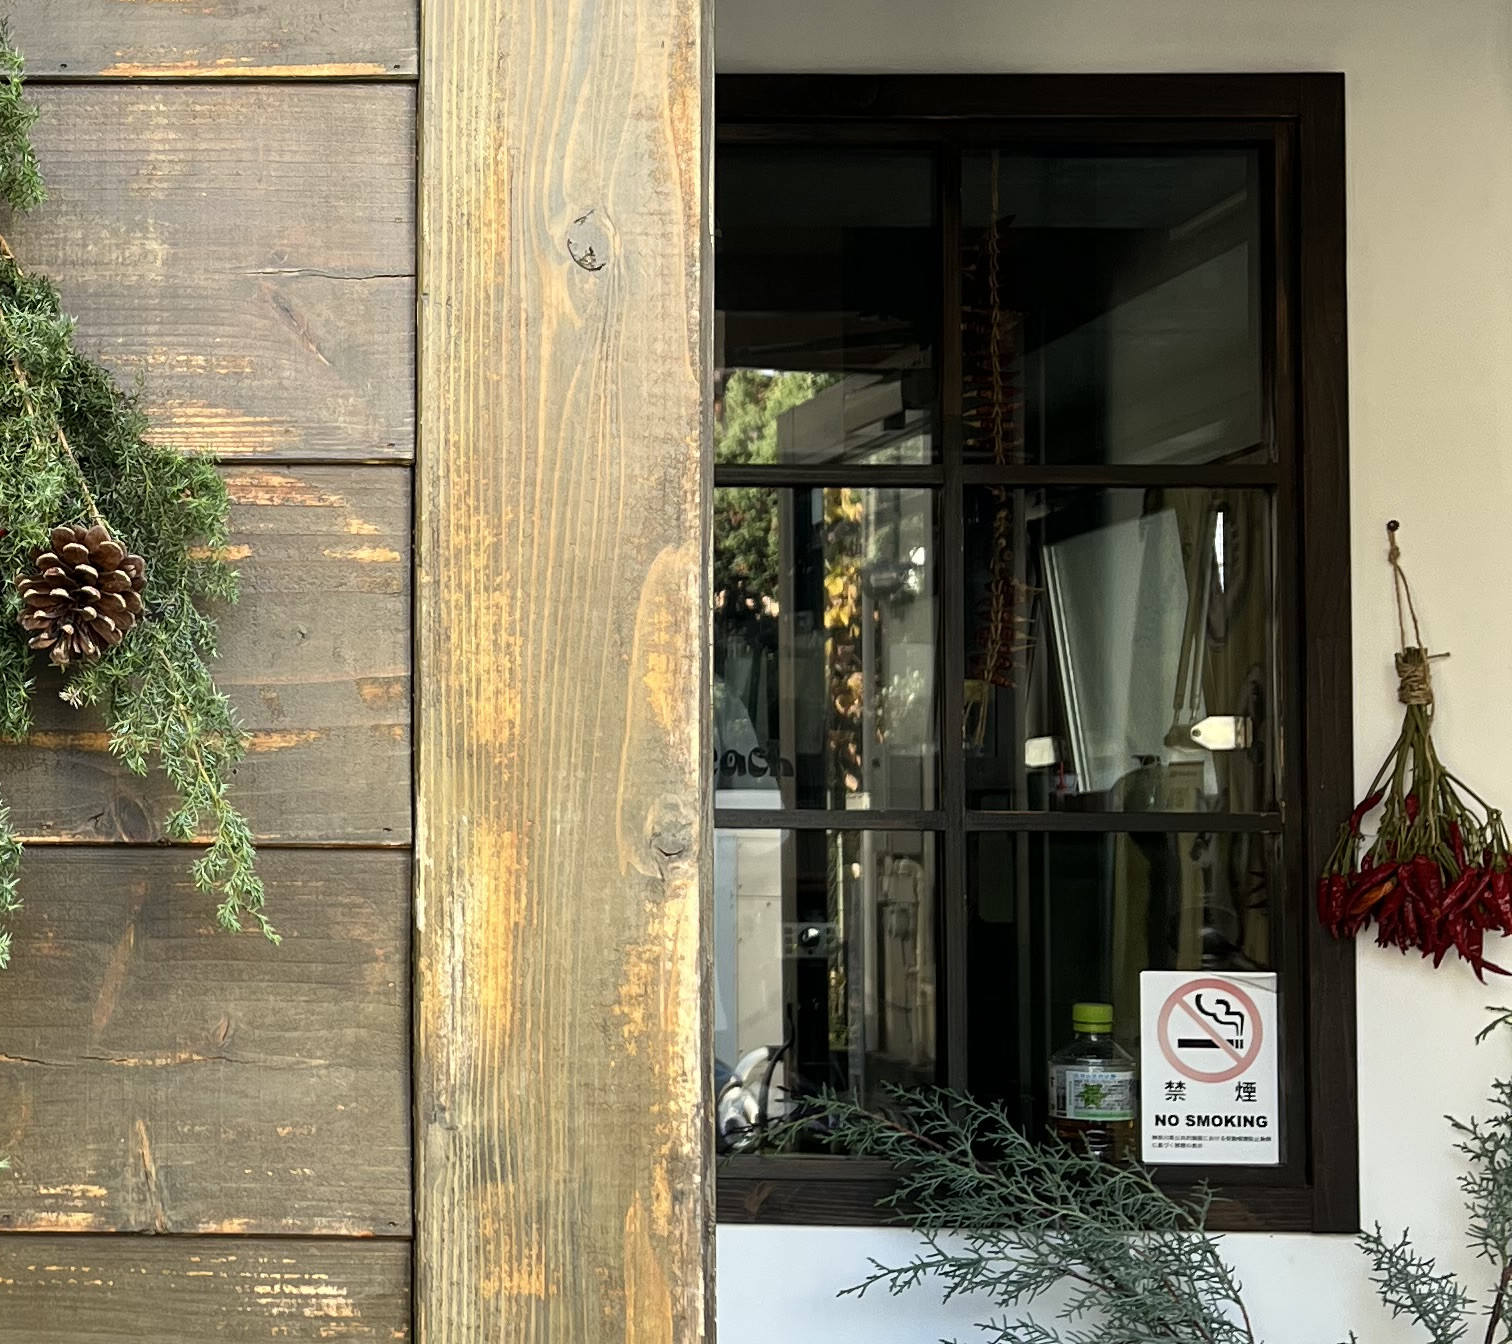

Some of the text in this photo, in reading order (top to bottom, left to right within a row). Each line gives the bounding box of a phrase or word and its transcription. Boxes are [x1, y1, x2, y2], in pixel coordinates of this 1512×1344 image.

[714, 738, 795, 777] ach
[1164, 1080, 1257, 1102] 禁煙
[1154, 1114, 1268, 1128] NO SMOKING
